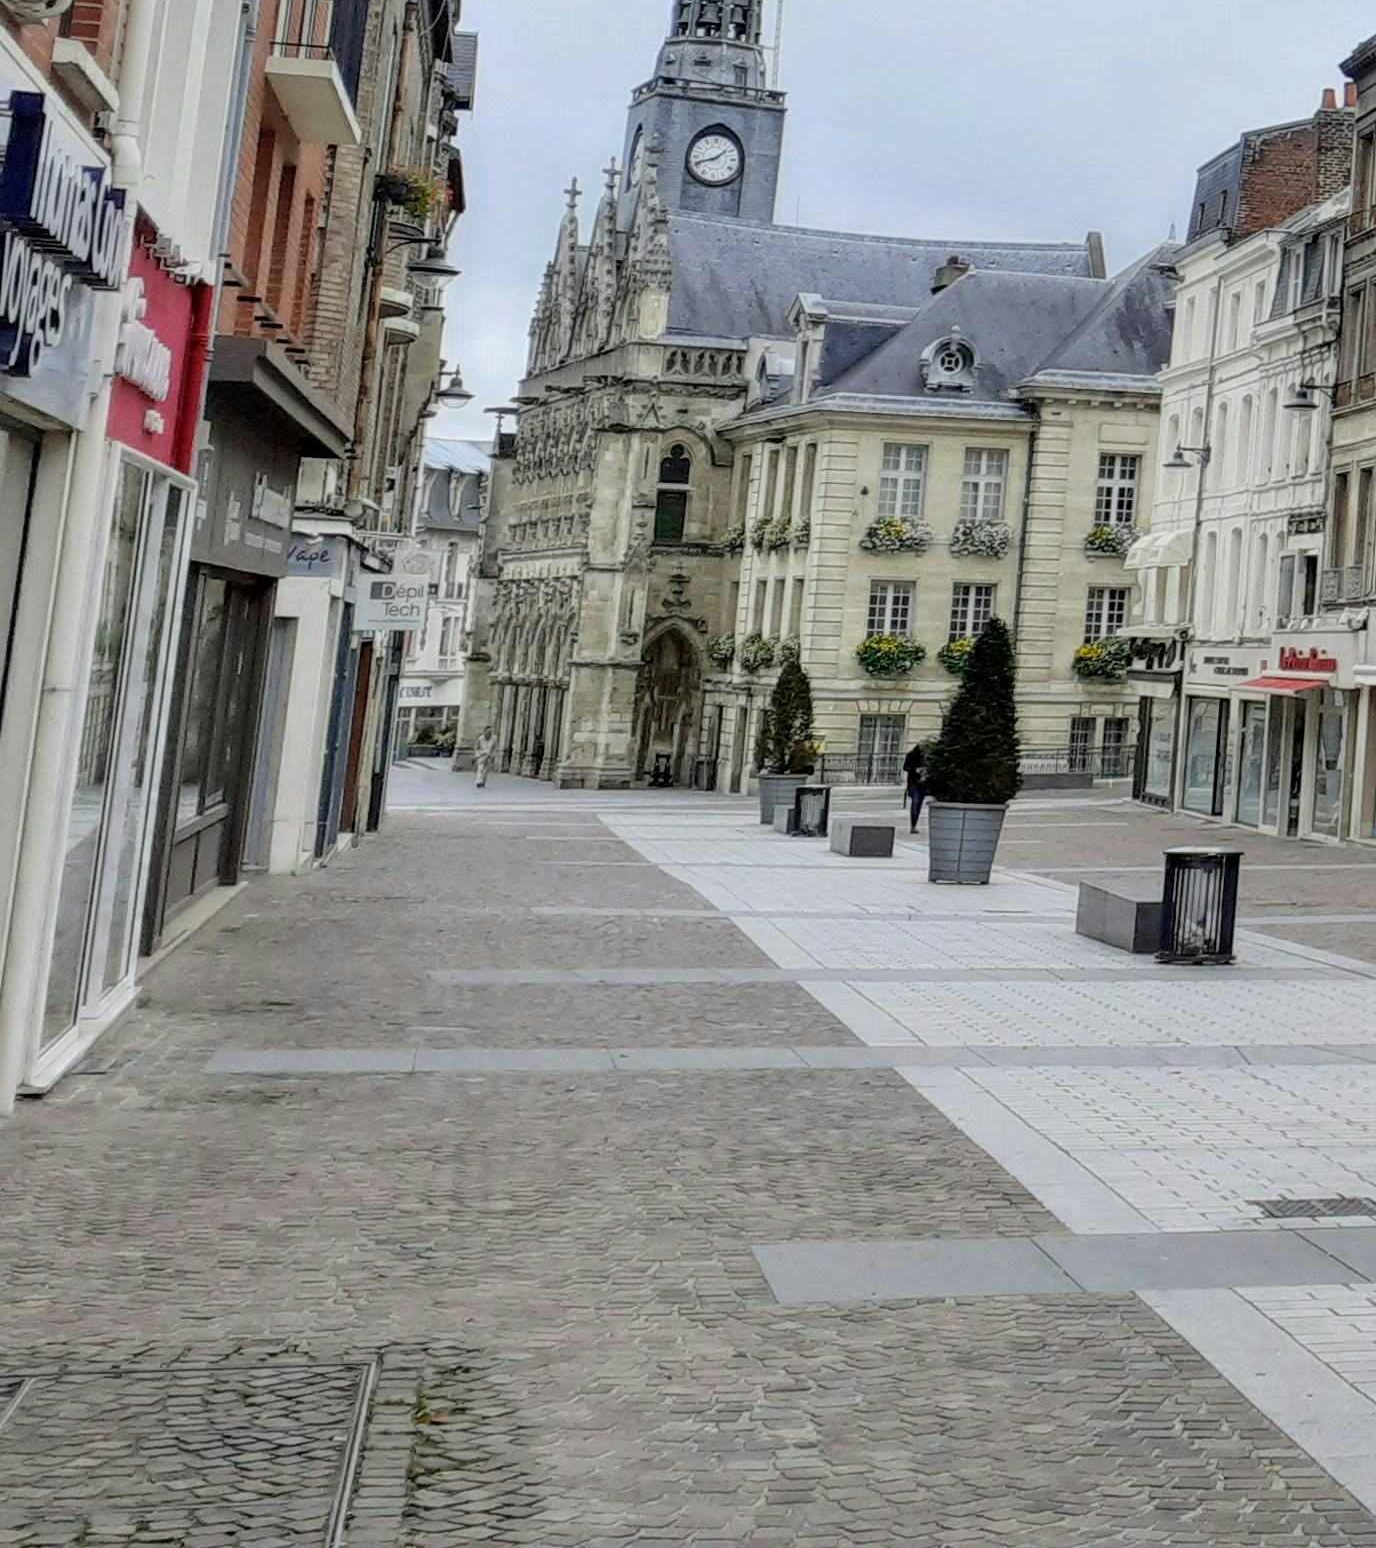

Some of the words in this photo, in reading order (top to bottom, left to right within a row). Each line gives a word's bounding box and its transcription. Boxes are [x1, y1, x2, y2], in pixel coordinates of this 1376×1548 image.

[30, 122, 95, 262] Thomas
[381, 583, 425, 603] Dépil
[384, 603, 420, 617] Tech
